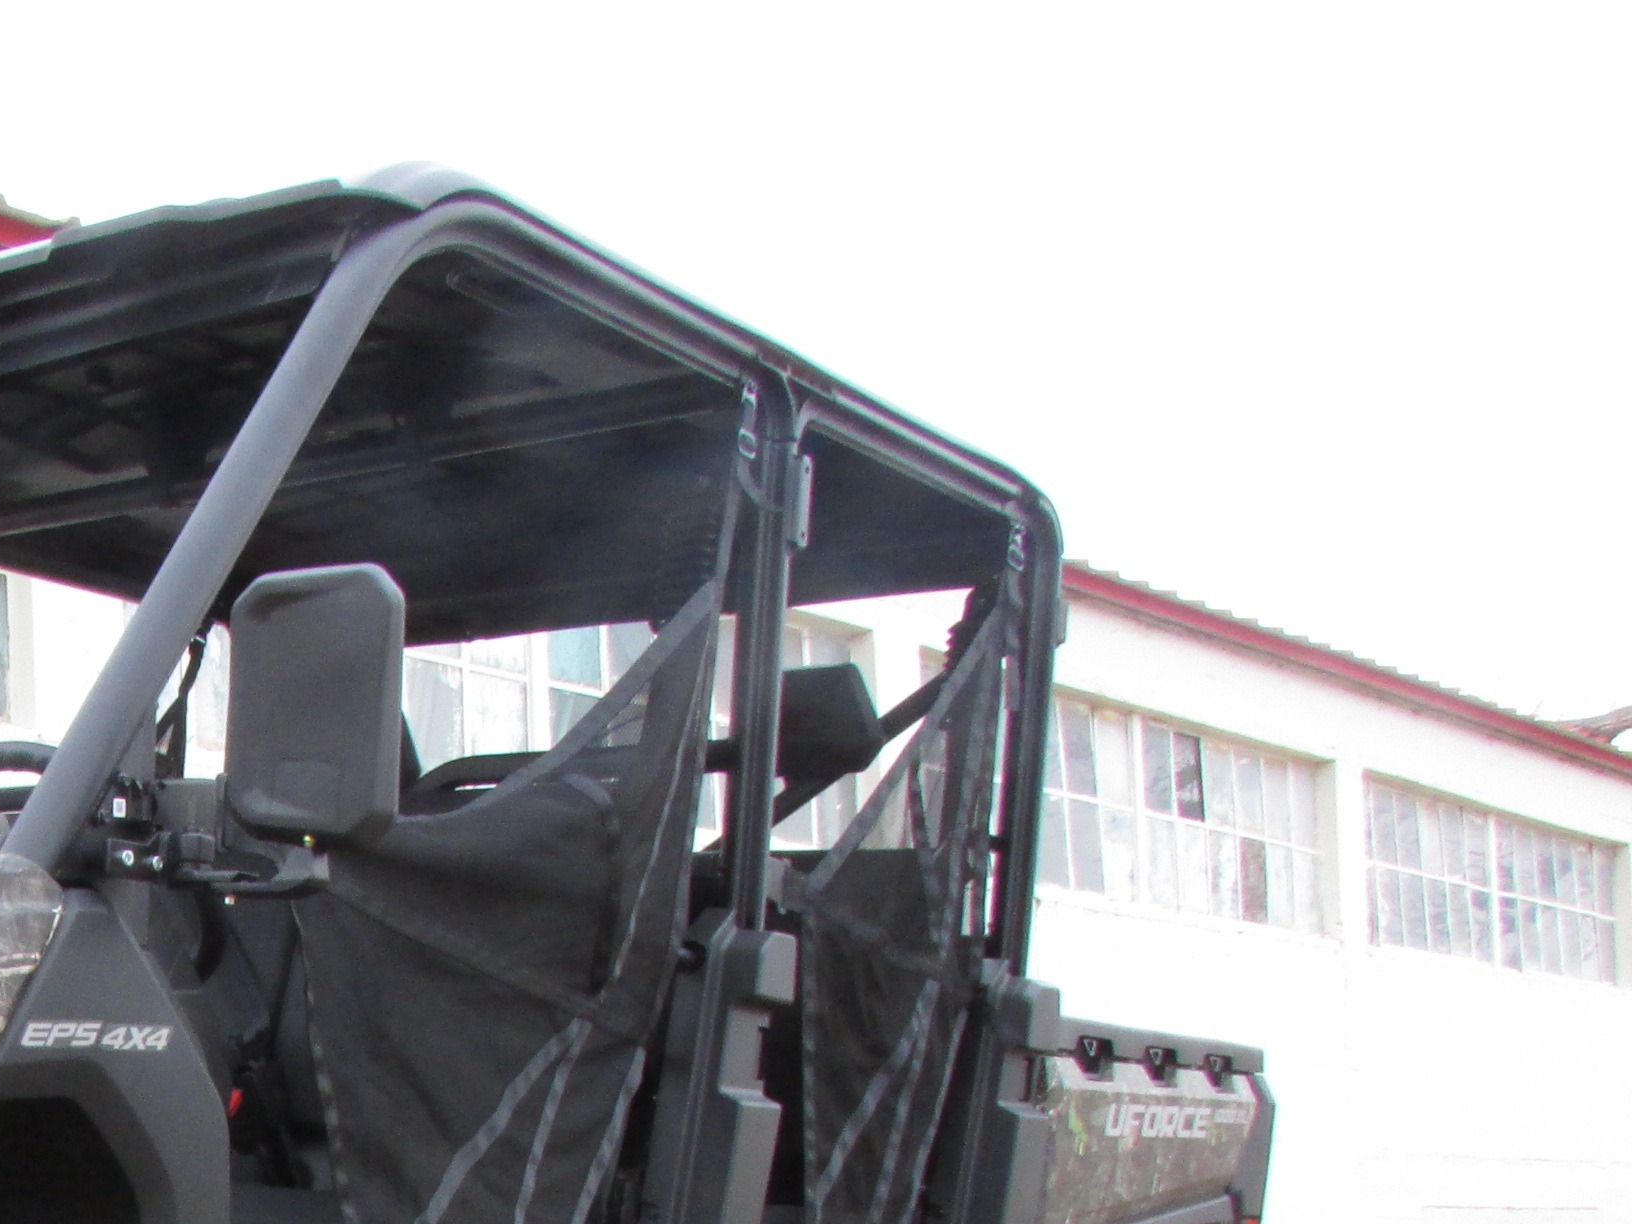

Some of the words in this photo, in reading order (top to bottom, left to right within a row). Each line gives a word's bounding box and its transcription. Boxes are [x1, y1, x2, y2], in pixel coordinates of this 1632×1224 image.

[20, 1021, 103, 1047] EPS
[101, 1026, 172, 1051] 4X4
[1104, 1103, 1212, 1138] UFORCE
